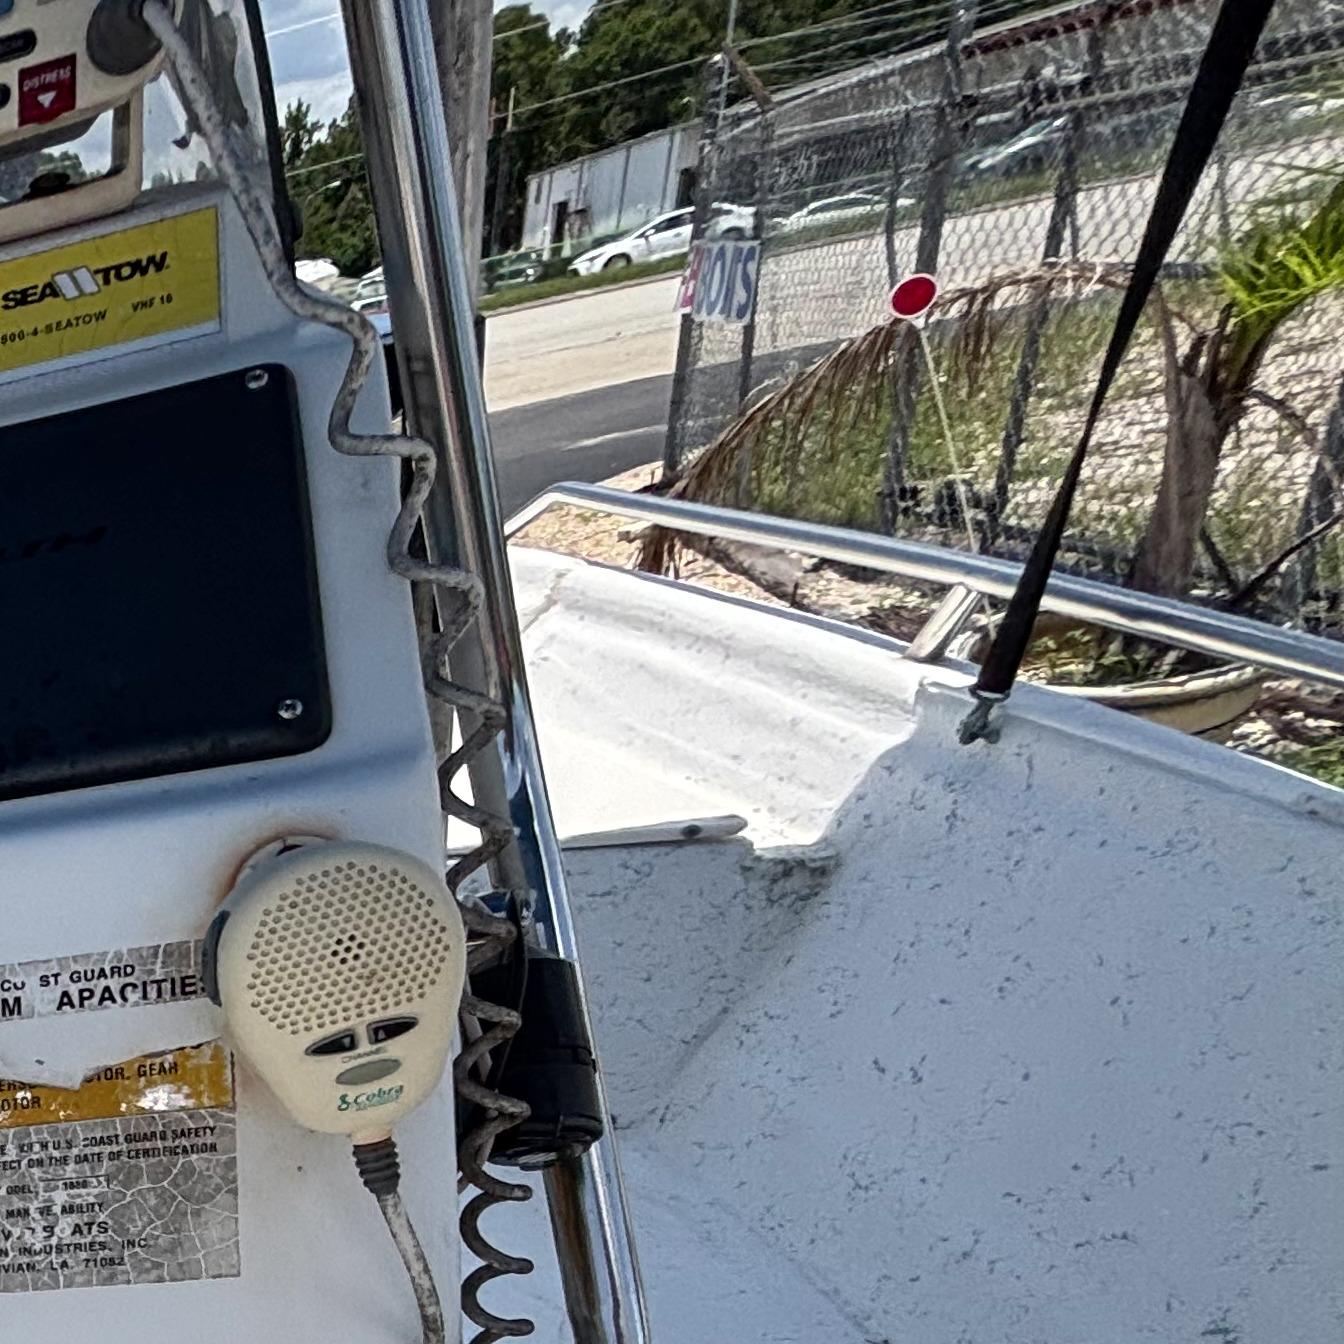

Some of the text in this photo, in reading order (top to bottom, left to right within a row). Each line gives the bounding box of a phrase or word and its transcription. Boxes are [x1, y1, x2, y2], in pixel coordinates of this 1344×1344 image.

[23, 64, 72, 92] DISTRESS
[0, 250, 169, 311] SEA TOW
[131, 295, 154, 313] VHF
[69, 963, 136, 984] GUARD
[353, 1084, 404, 1105] Cobra
[123, 1129, 167, 1145] GUARD
[171, 1125, 218, 1141] SAFETY
[27, 1157, 45, 1168] ON
[48, 1155, 71, 1167] THE
[74, 1152, 104, 1165] DATE
[108, 1149, 124, 1161] OF
[127, 1142, 218, 1160] CERTIFICATION
